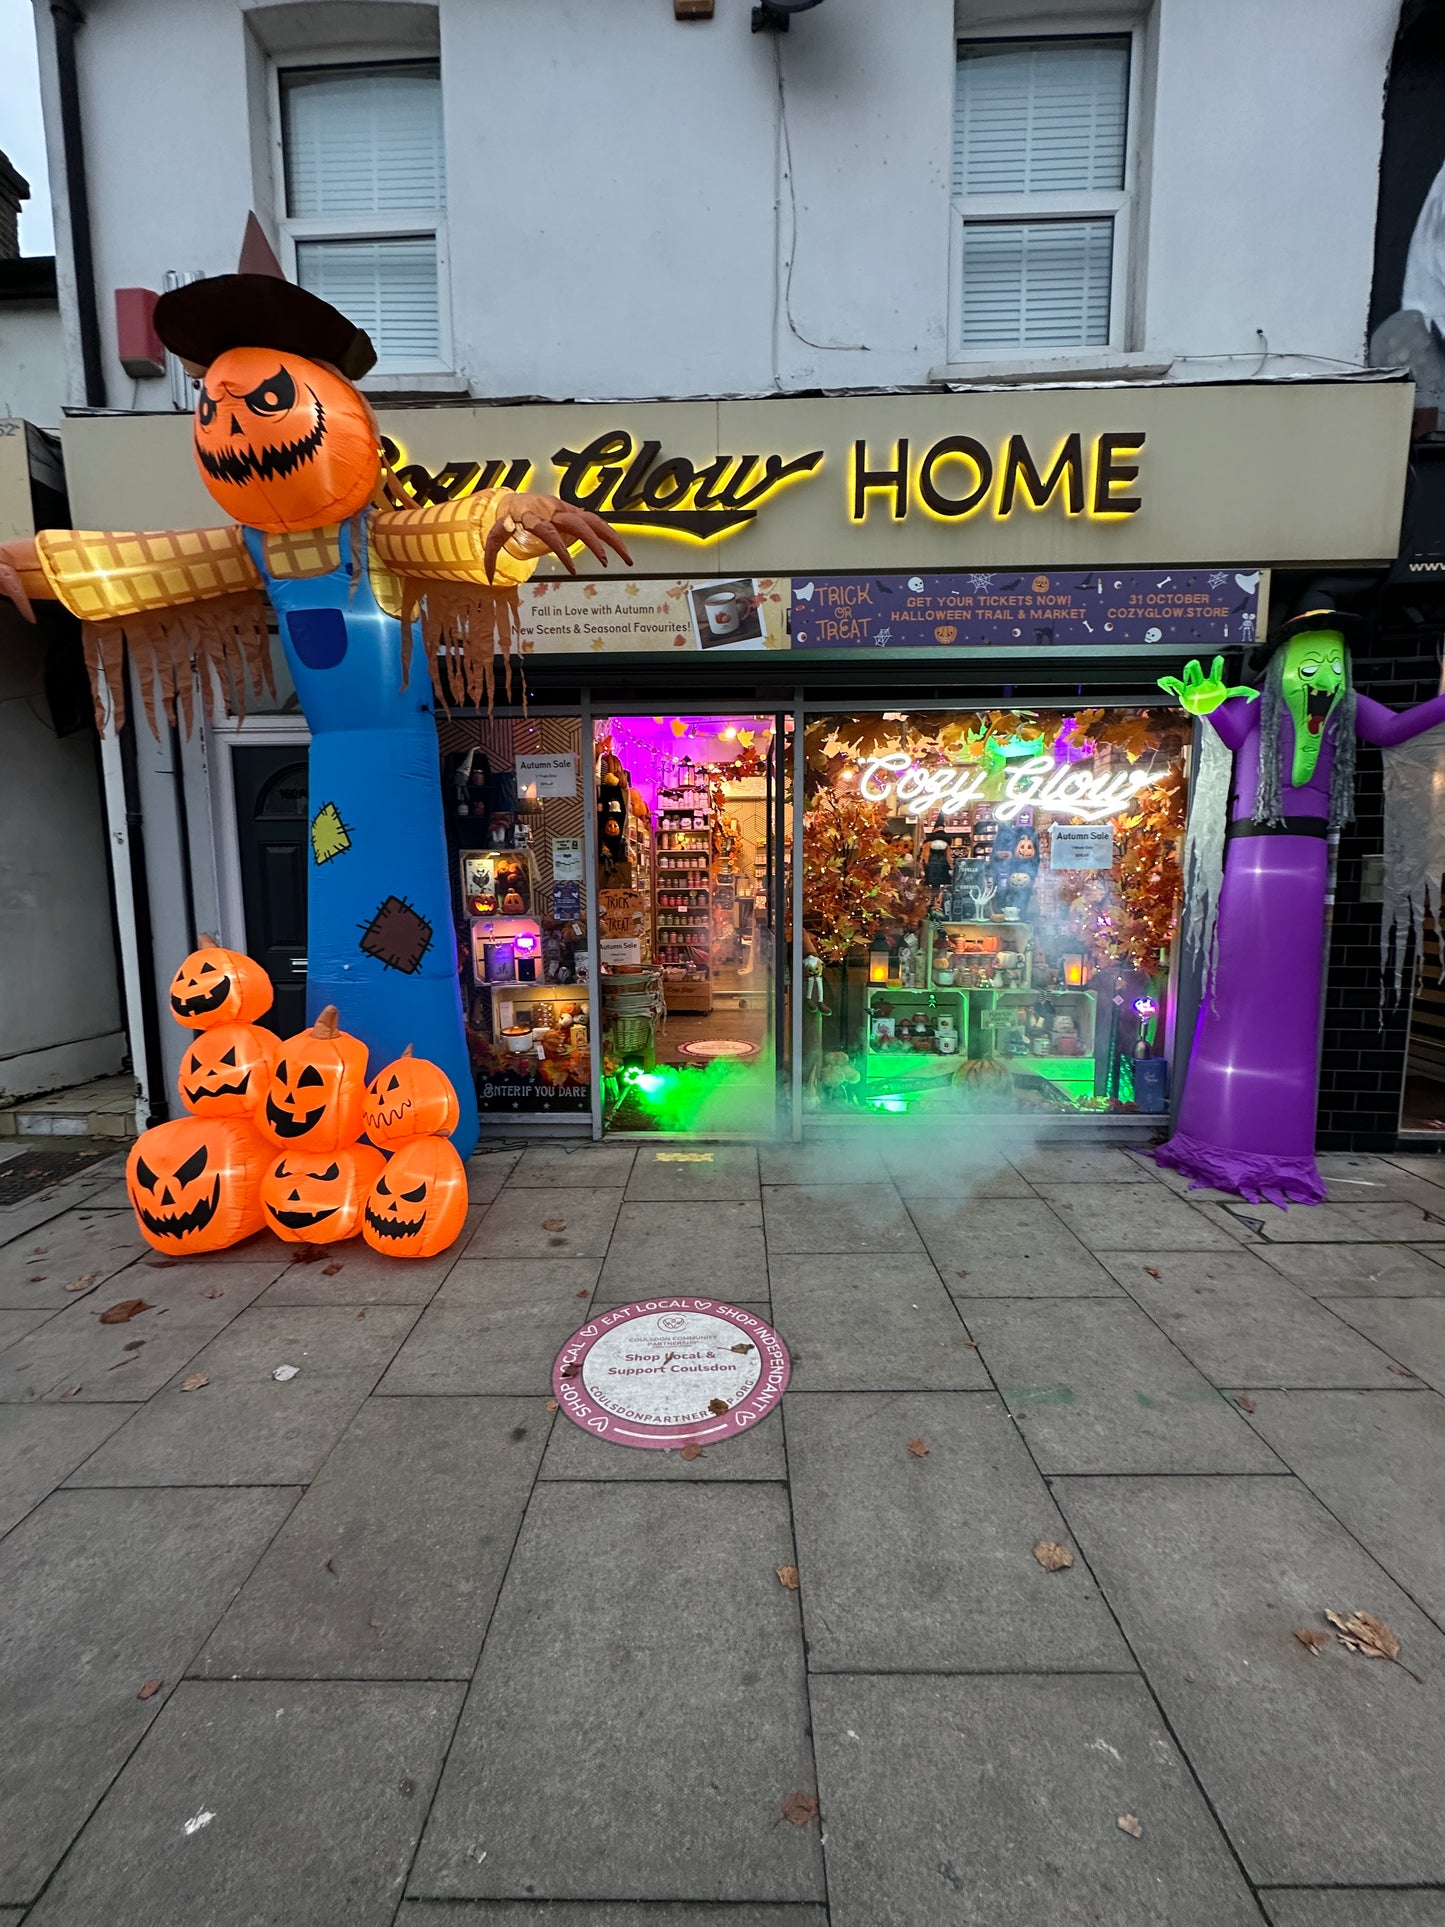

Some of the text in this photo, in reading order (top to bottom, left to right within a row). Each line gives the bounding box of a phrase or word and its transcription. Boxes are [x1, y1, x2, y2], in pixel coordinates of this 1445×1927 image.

[551, 430, 824, 539] Glow
[854, 433, 1146, 519] HOME
[814, 583, 874, 606] TRICK
[906, 595, 1072, 607] GET YOUR TICKETS NOW!
[1130, 593, 1210, 604] 31 OCTOBER
[531, 605, 654, 616] Fall in Love with Autumn
[834, 606, 852, 619] OR
[891, 609, 1086, 621] HALLOWEEN TRAIL & MARKET
[1107, 607, 1229, 618] COZYGLOW.STORE
[512, 622, 691, 635] New Scents & Seasonal Favourites!
[815, 618, 872, 641] TREAT
[520, 760, 571, 769] Autumn Sale
[859, 753, 1170, 821] Cozy Glow
[1057, 831, 1109, 840] Autumn Sale
[605, 896, 629, 909] TRICK
[607, 917, 633, 931] TREAT
[534, 1085, 555, 1097] YOU
[558, 1086, 587, 1097] DARE
[601, 1300, 690, 1325] EAT LOCAL
[625, 1353, 660, 1362] Shop
[706, 1351, 716, 1359] &
[716, 1305, 785, 1412] SHOP INDEPENDANT
[608, 1364, 736, 1376] Support Coulsdon
[560, 1383, 592, 1417] SHOP
[590, 1379, 754, 1423] COULSDONPARTNERP.ORG
